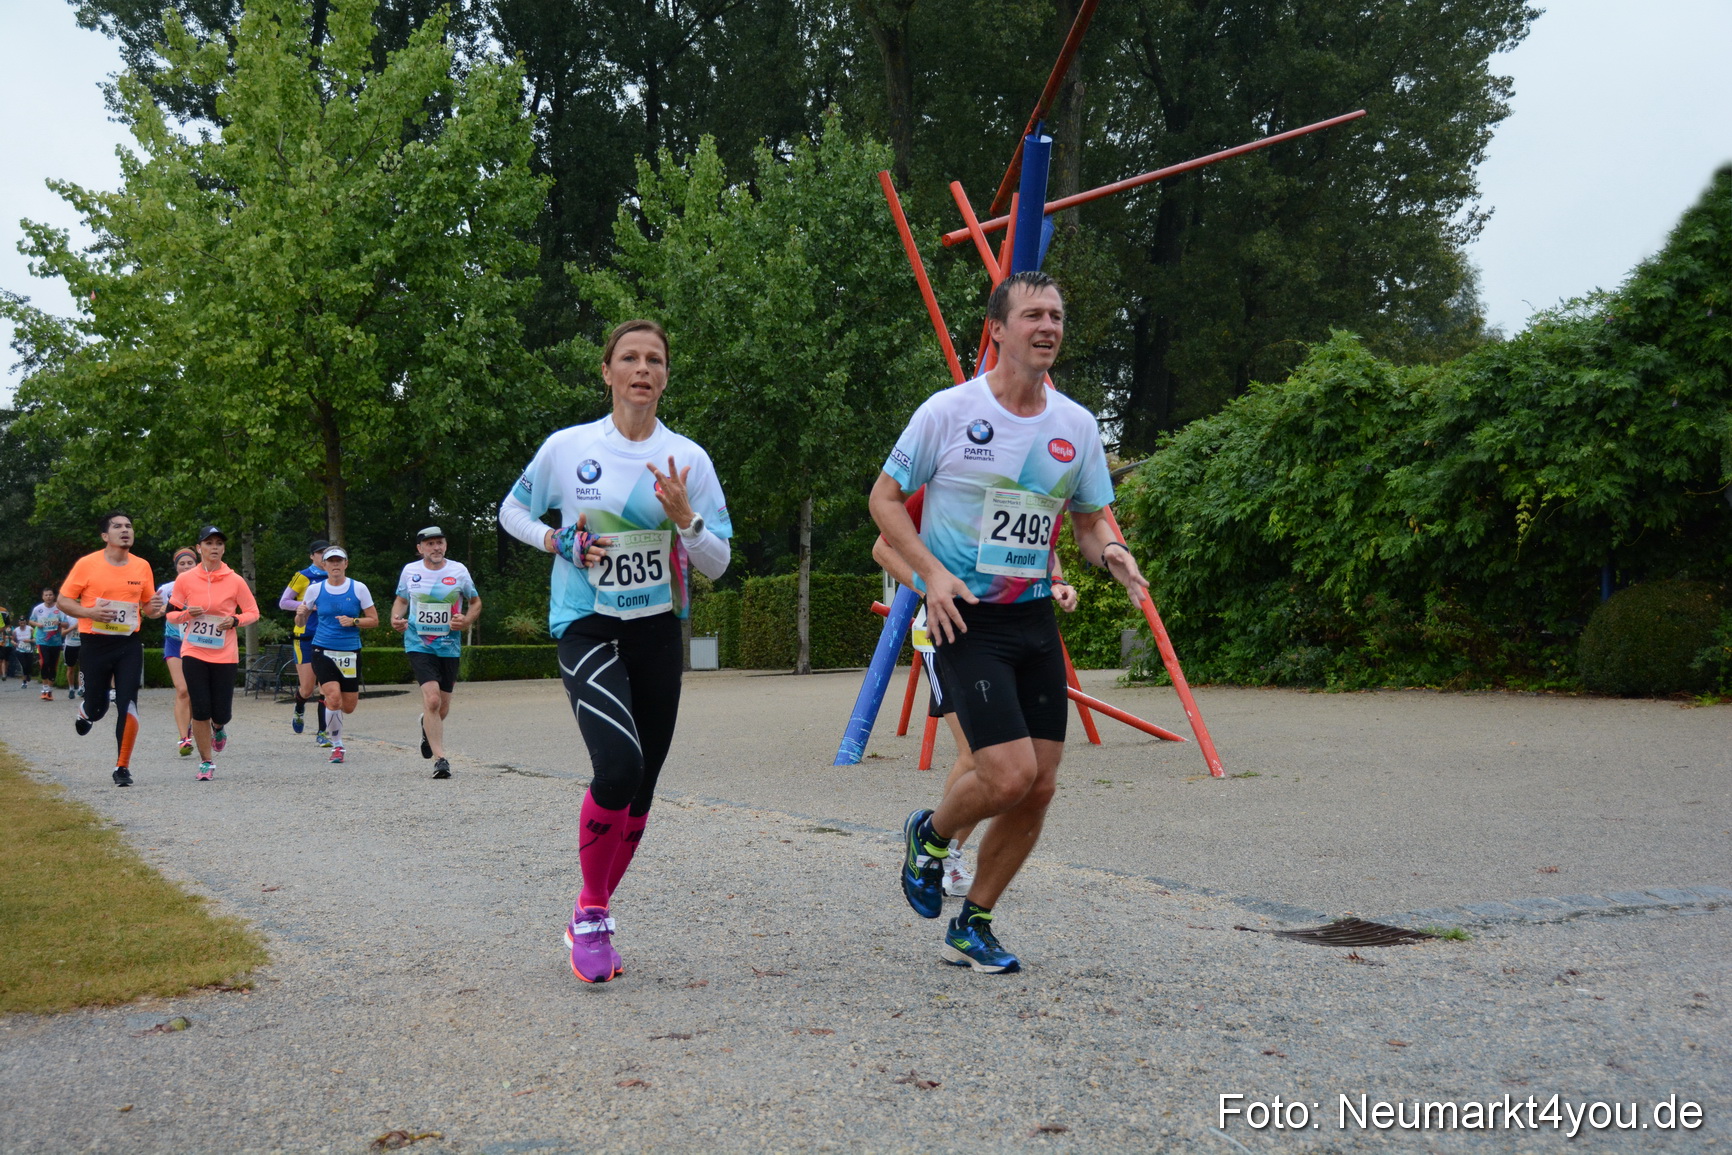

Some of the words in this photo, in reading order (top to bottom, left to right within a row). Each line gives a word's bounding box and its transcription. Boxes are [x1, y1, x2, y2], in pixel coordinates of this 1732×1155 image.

[964, 448, 994, 456] PARTL
[1051, 443, 1072, 457] Hervis
[576, 487, 601, 495] PARTL
[991, 510, 1051, 545] 2493
[1005, 552, 1036, 566] Arnold
[599, 550, 662, 586] 2635
[617, 594, 650, 607] Conny
[419, 611, 448, 624] 2530
